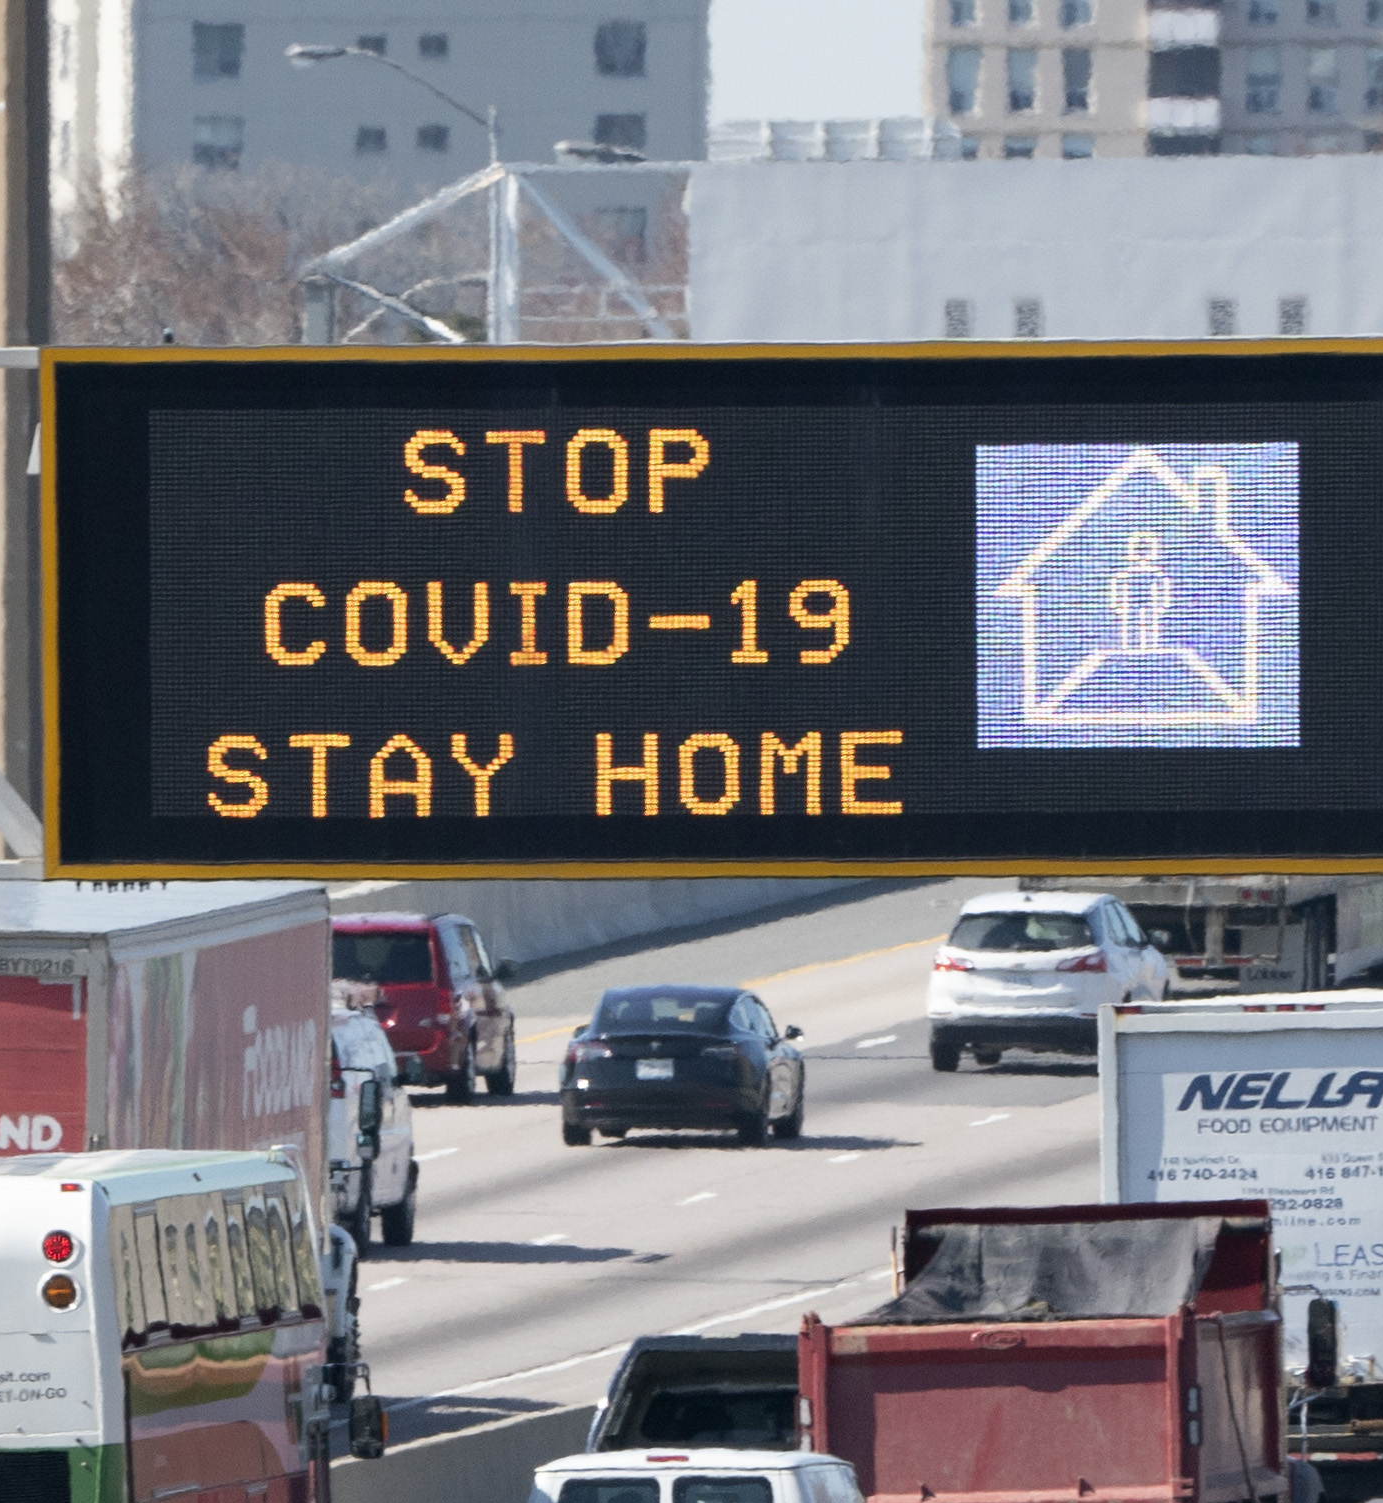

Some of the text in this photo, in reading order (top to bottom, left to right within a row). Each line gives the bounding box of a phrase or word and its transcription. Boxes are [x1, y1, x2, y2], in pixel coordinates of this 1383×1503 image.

[405, 429, 710, 514] STOP
[265, 580, 850, 667] COVID-19
[208, 731, 903, 818] STAY HOME
[1197, 1114, 1379, 1135] FOOD EQUIPMENT
[1147, 1168, 1259, 1182] 416 740-2424
[1305, 1166, 1336, 1180] 416
